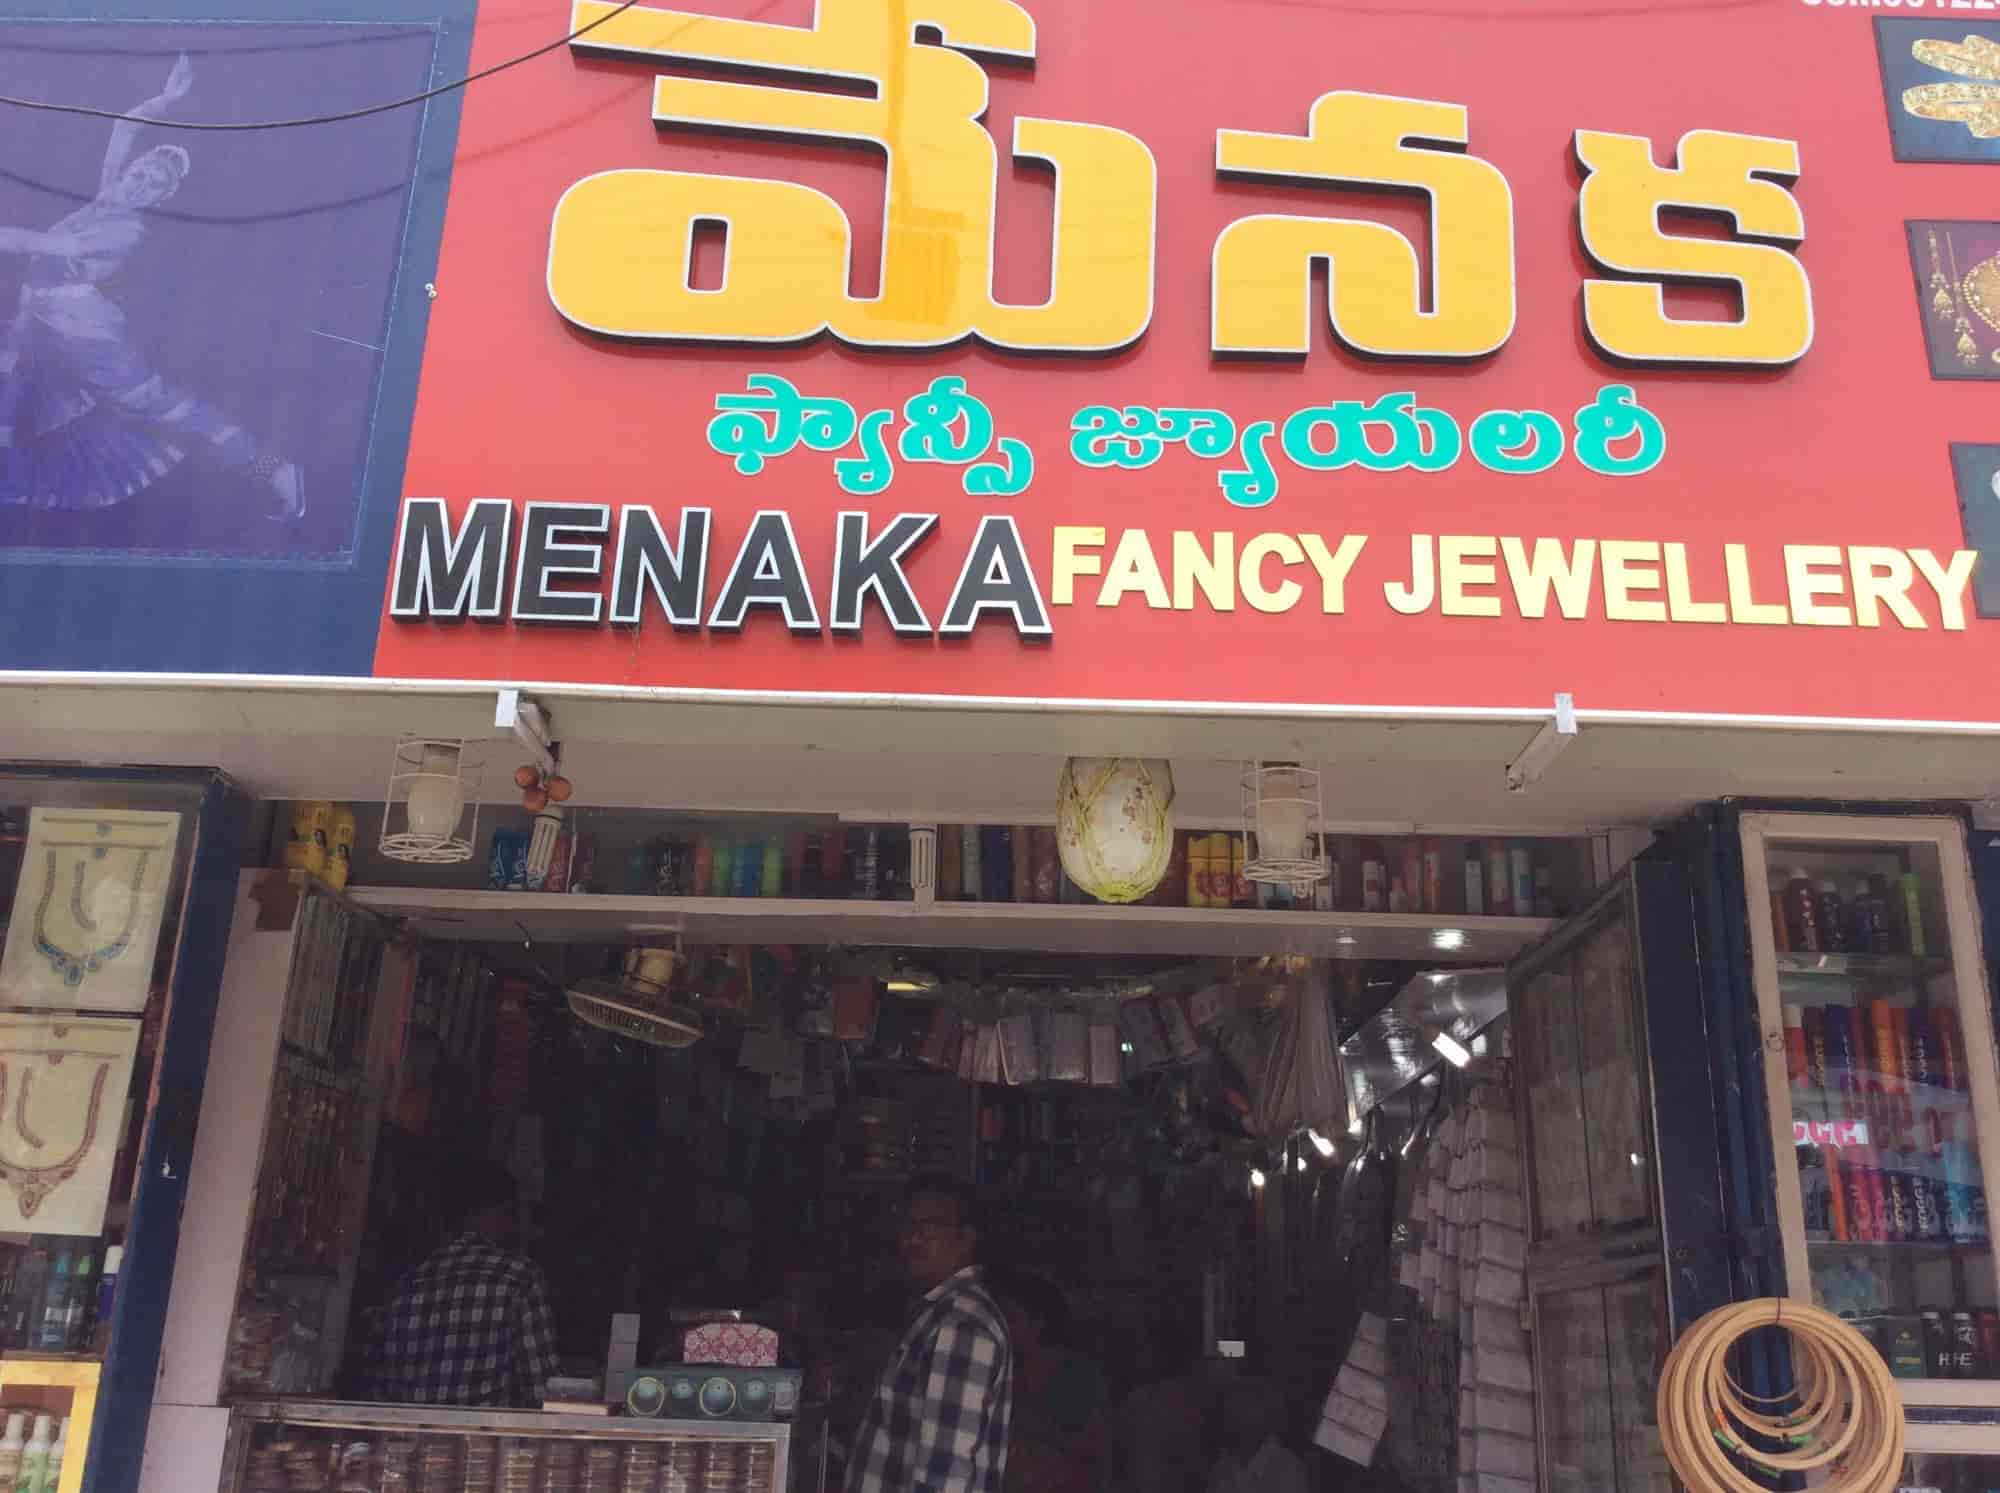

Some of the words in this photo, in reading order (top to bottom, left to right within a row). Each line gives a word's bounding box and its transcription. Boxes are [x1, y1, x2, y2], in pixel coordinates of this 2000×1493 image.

[546, 0, 1816, 366] మేనక
[390, 497, 1053, 641] MENAKA
[1050, 526, 1367, 614] FANCY
[1384, 534, 1979, 631] JEWELLERY
